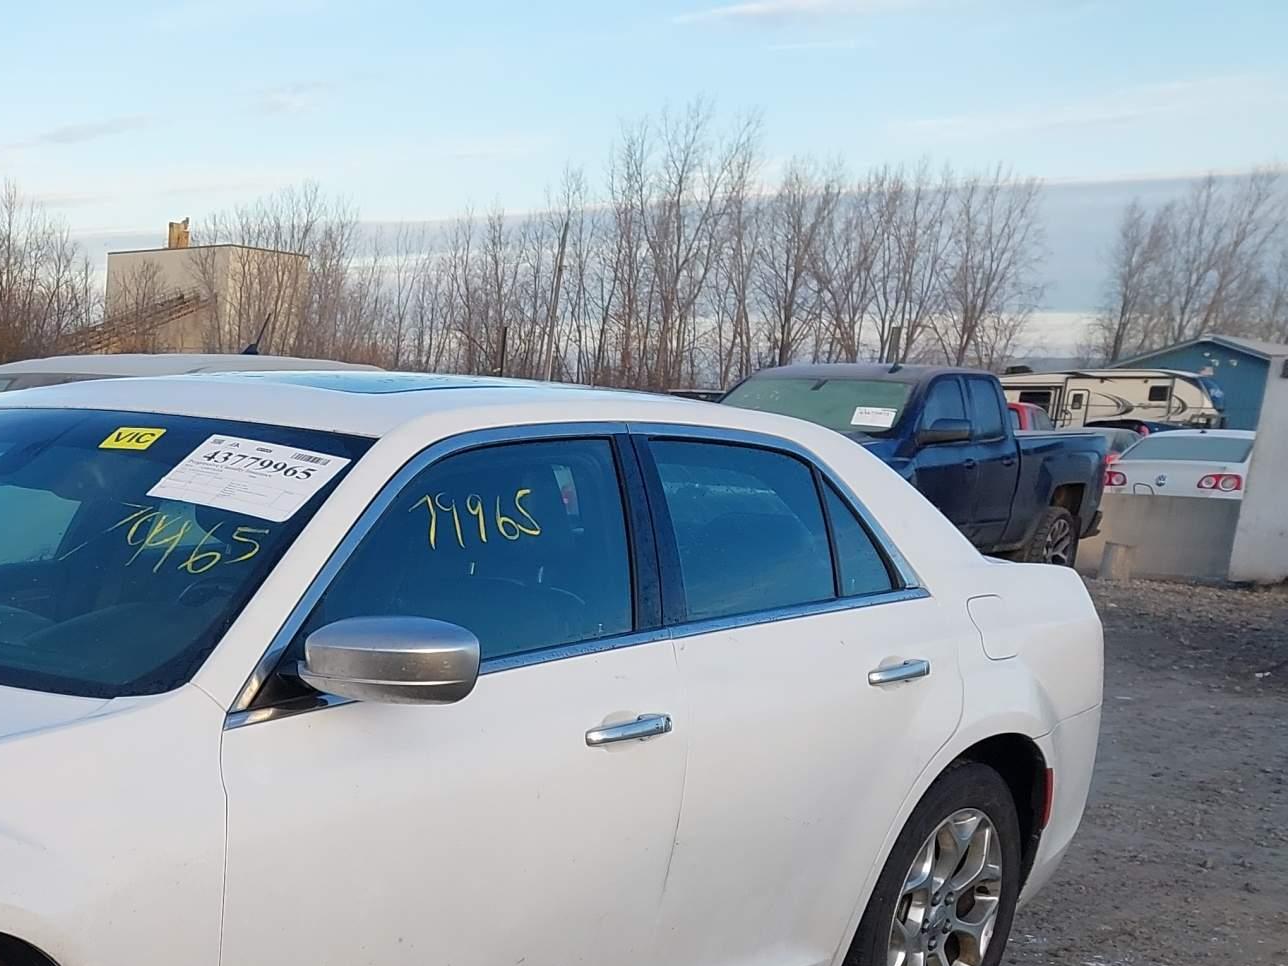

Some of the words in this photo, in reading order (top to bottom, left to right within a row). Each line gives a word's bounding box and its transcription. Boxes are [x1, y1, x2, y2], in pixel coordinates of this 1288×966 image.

[114, 431, 156, 444] VIC
[202, 449, 317, 481] 43779965
[407, 488, 542, 550] 79965
